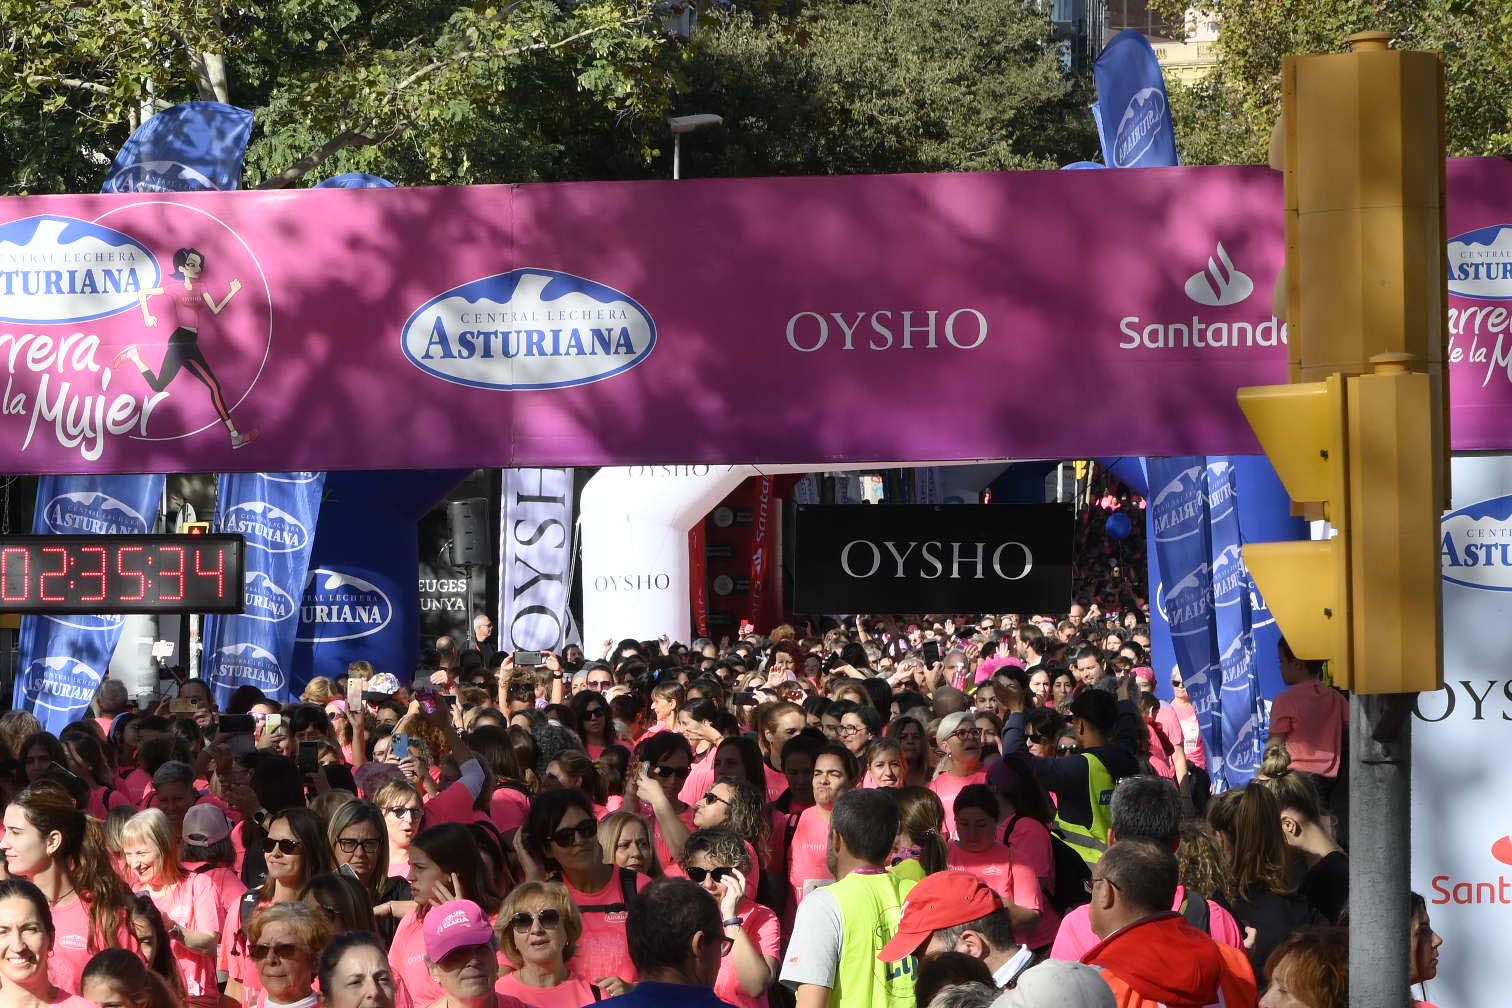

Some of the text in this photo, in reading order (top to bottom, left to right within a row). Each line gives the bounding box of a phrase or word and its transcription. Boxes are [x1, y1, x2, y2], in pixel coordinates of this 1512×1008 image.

[63, 250, 137, 263] LECHERA
[460, 309, 628, 323] CENTRAL LECHERA
[786, 308, 988, 353] OYSHO
[422, 314, 637, 360] ASTURIANA
[1470, 336, 1486, 363] la
[1, 376, 27, 415] la
[22, 367, 172, 462] Mujer
[1, 547, 224, 601] 02:35:34
[840, 539, 1034, 581] OYSHO
[595, 573, 670, 592] OYSHO
[421, 597, 466, 611] UNYA
